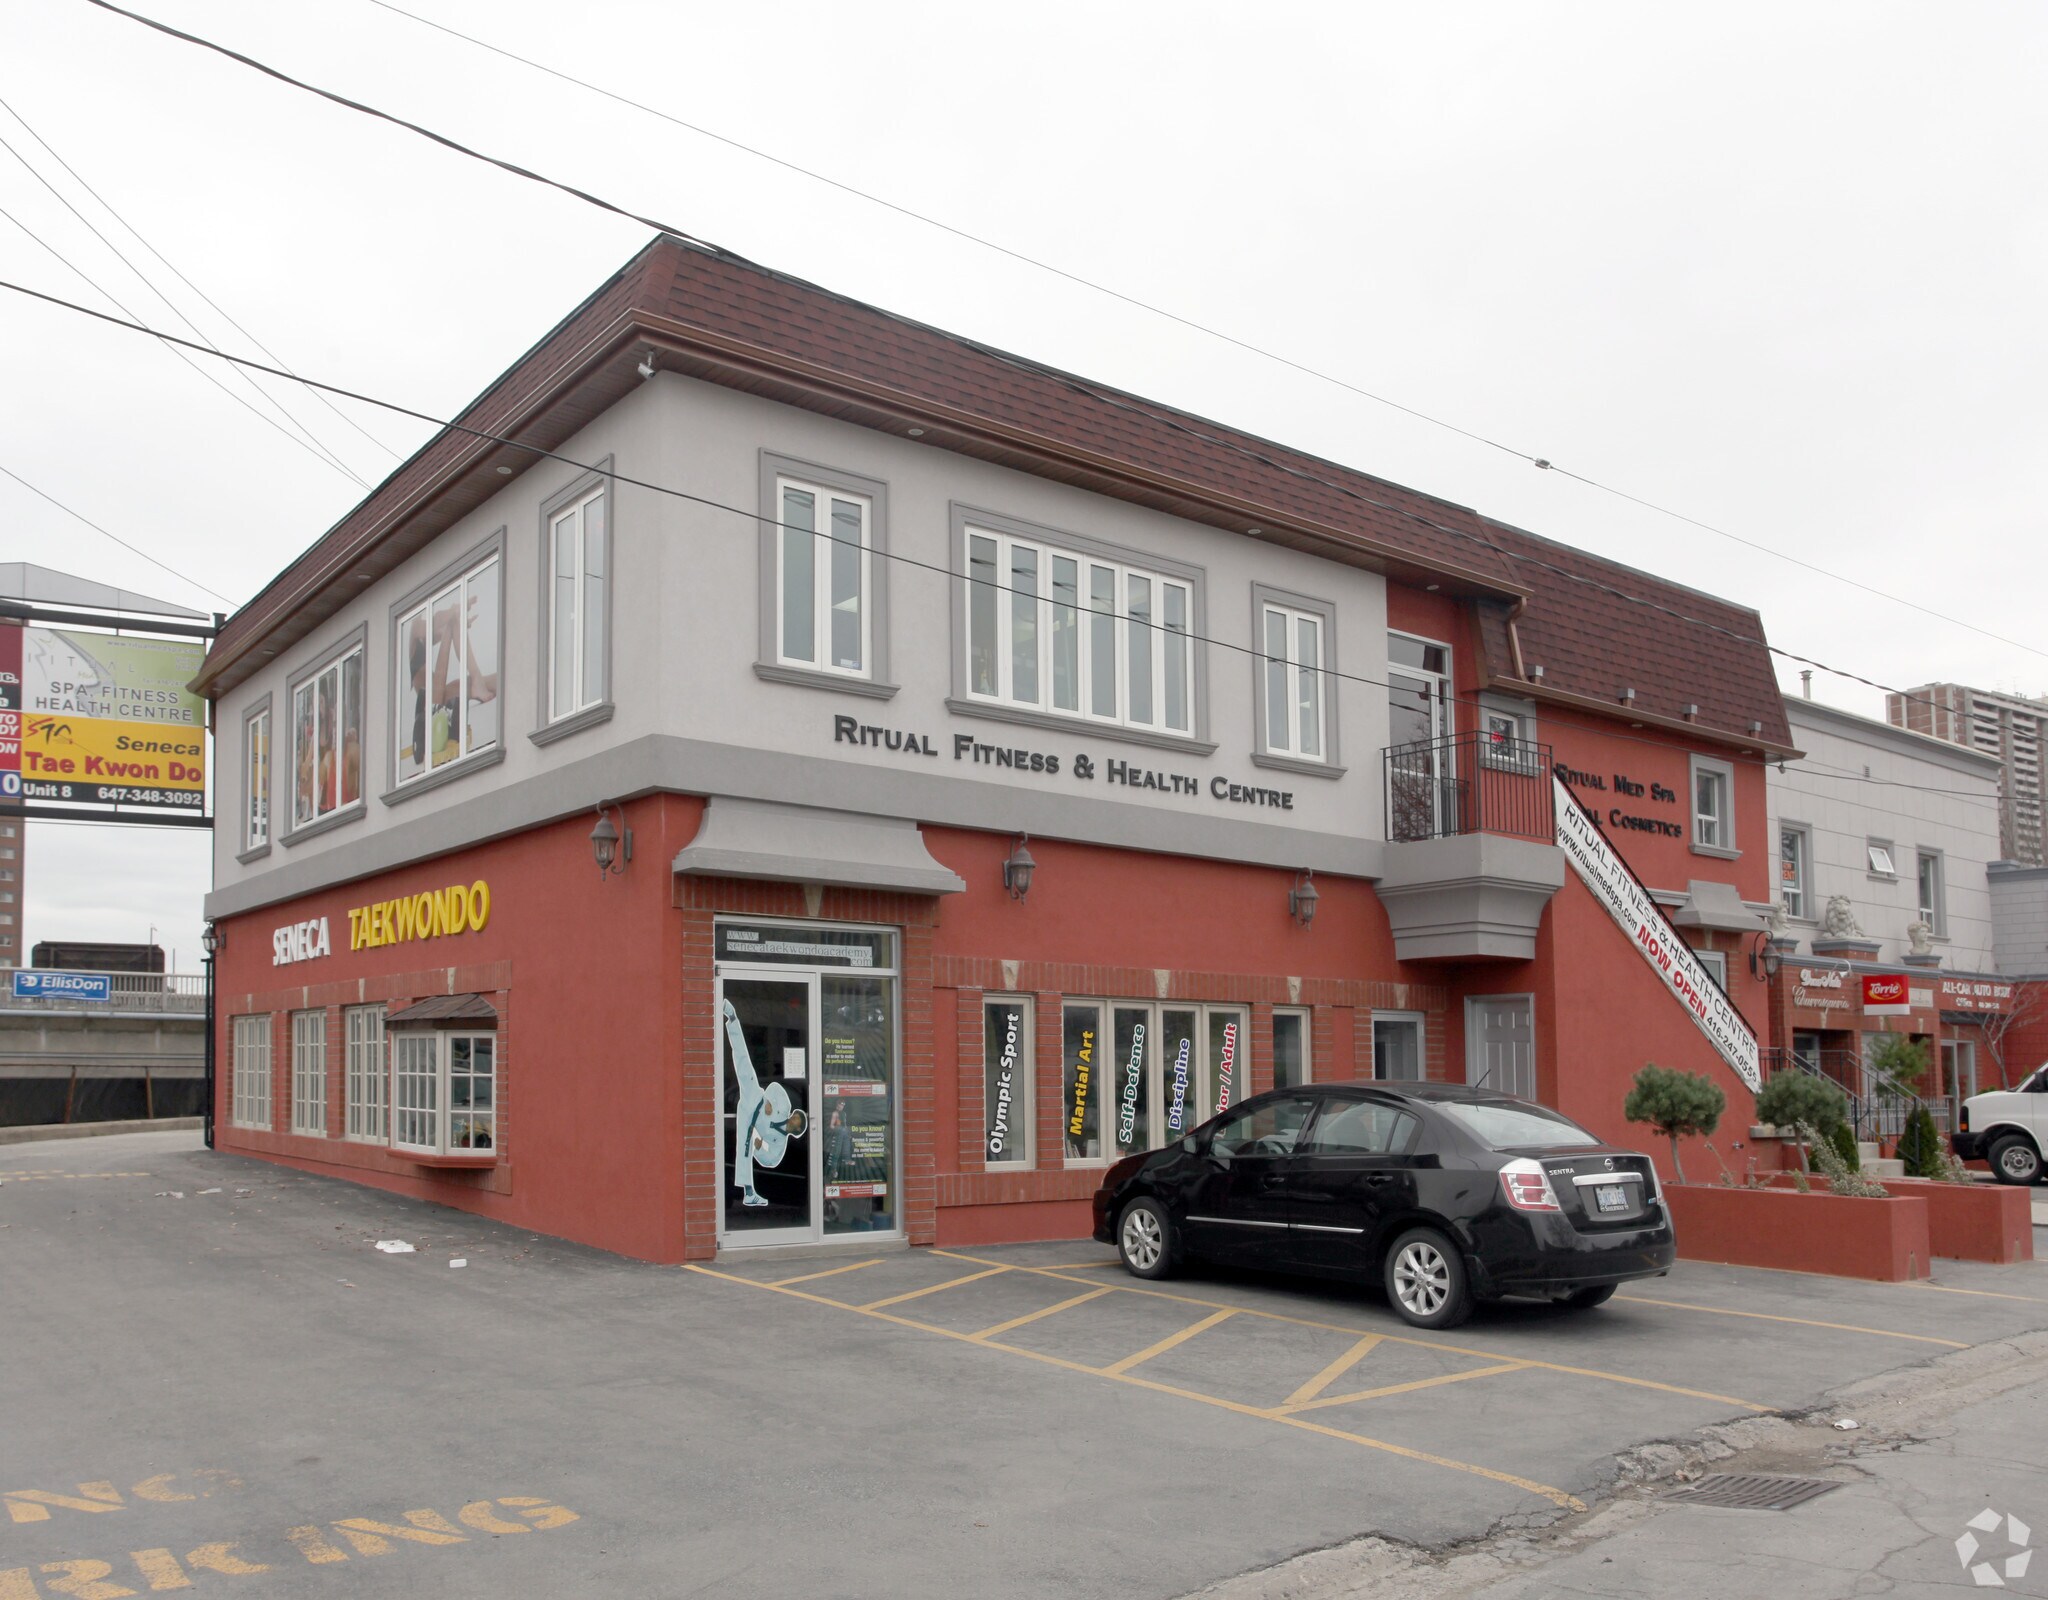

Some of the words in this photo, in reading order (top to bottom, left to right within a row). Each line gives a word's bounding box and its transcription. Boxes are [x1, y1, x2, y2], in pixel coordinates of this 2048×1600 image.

[36, 697, 111, 714] HEALTH
[119, 704, 192, 721] CENTRE
[102, 686, 178, 704] FITNESS
[25, 751, 75, 773] Tae
[85, 755, 159, 780] Kwon
[169, 761, 202, 782] Do
[116, 735, 201, 756] Seneca
[834, 714, 938, 757] RITUAL
[954, 733, 1059, 774] FITNESS
[1073, 753, 1095, 779] &
[1107, 758, 1199, 795] HEALTH
[1210, 776, 1294, 810] CENTRE
[23, 783, 57, 797] Unit
[61, 786, 72, 797] 8
[98, 787, 202, 805] 647-348-3092
[1614, 774, 1644, 798] MED
[272, 916, 331, 966] SENECA
[347, 880, 490, 951] TAEKWONDO
[1564, 803, 1608, 869] RITUAL
[1610, 862, 1658, 932] FITNESS
[1659, 928, 1668, 947] &
[1669, 941, 1713, 1003] HEALTH
[1714, 998, 1757, 1061] CENTRE
[851, 957, 873, 967] com
[1557, 823, 1638, 931] www.ritualmedspa.com
[1637, 925, 1672, 972] NOW
[1674, 971, 1707, 1020] OPEN
[1707, 1016, 1757, 1083] 416-247-0555
[41, 975, 104, 990] EllisDon
[1000, 1012, 1019, 1069] Sport
[1079, 1030, 1094, 1063] Art
[1221, 1022, 1237, 1076] Adult
[1069, 1065, 1090, 1136] Martial
[1119, 1024, 1145, 1144] Self-Defence
[1168, 1038, 1190, 1130] Discipline
[989, 1071, 1012, 1154] Olympic
[1549, 1168, 1574, 1176] SENTRA
